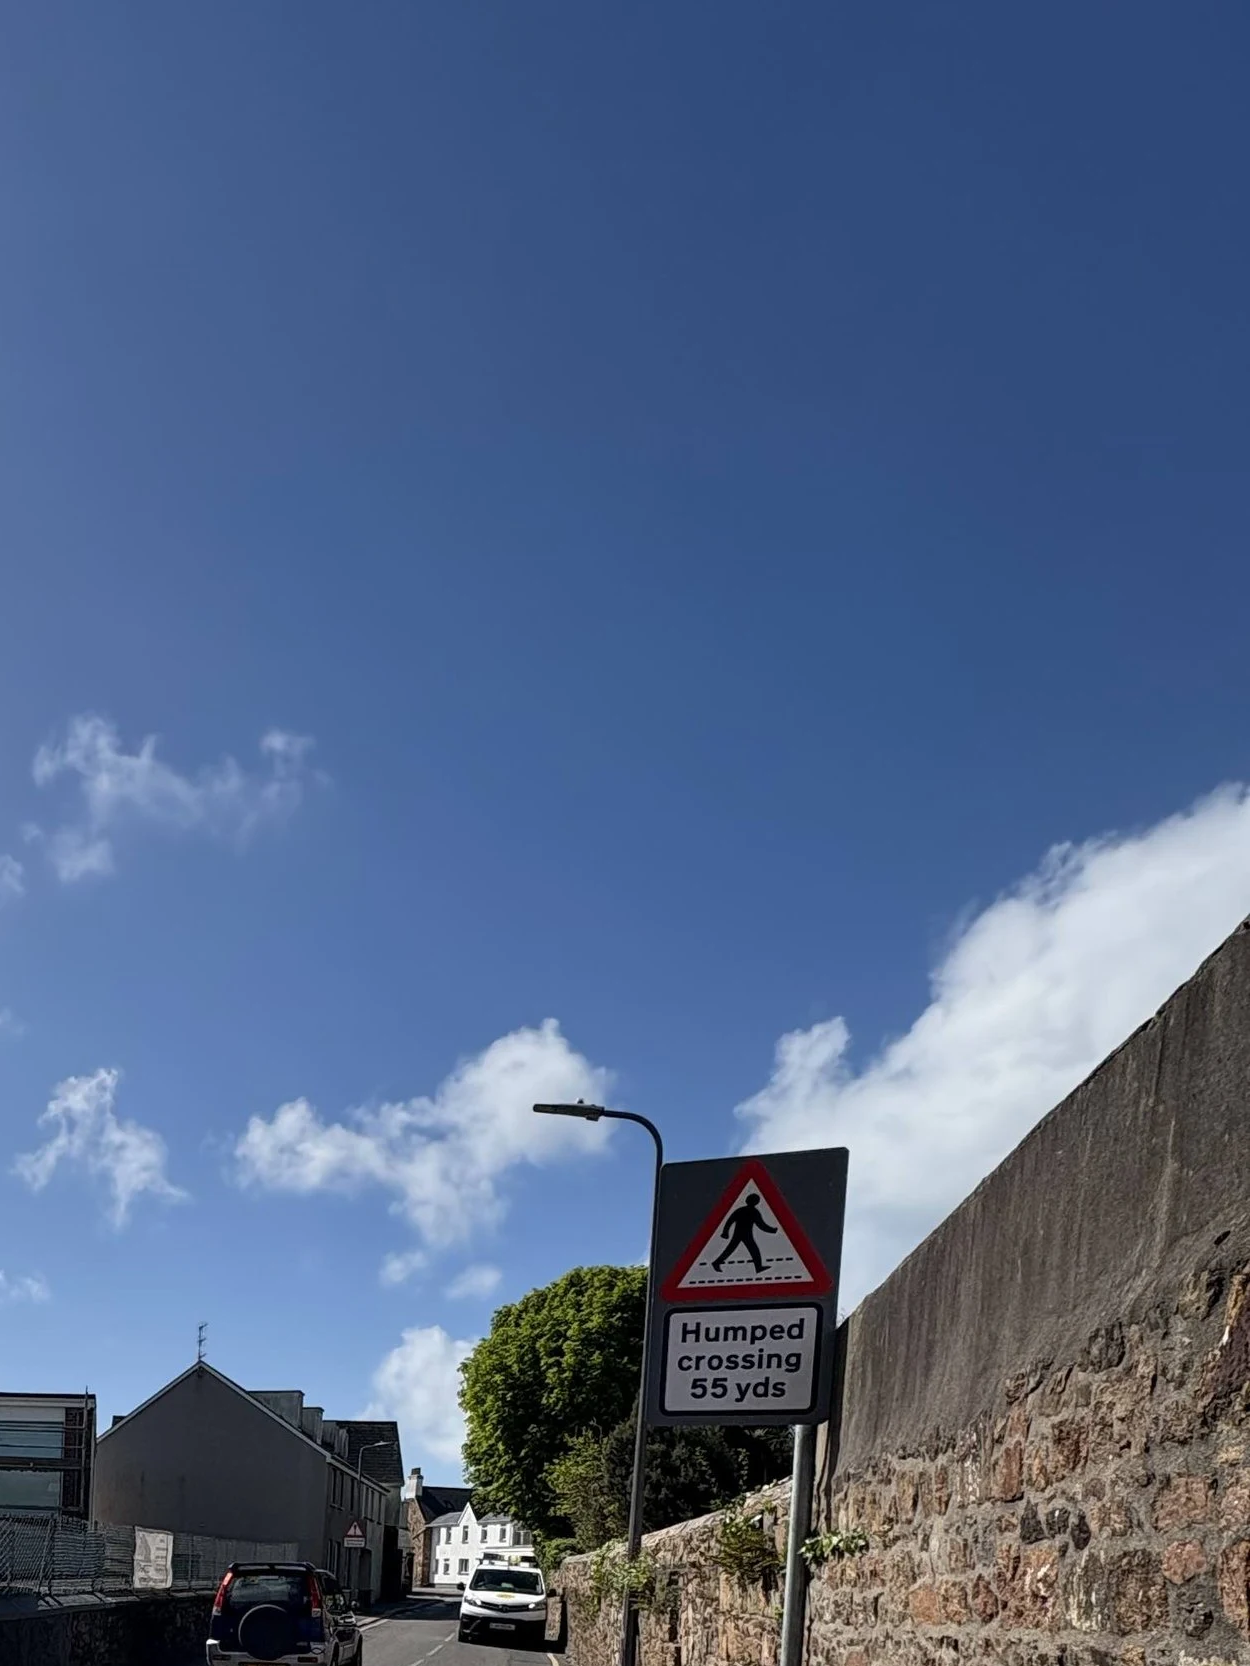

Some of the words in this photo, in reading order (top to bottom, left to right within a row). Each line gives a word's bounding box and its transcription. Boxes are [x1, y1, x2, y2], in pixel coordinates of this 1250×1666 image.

[681, 1318, 805, 1345] Humped
[677, 1348, 802, 1373] crossing
[690, 1377, 728, 1399] 55
[734, 1376, 786, 1403] yds
